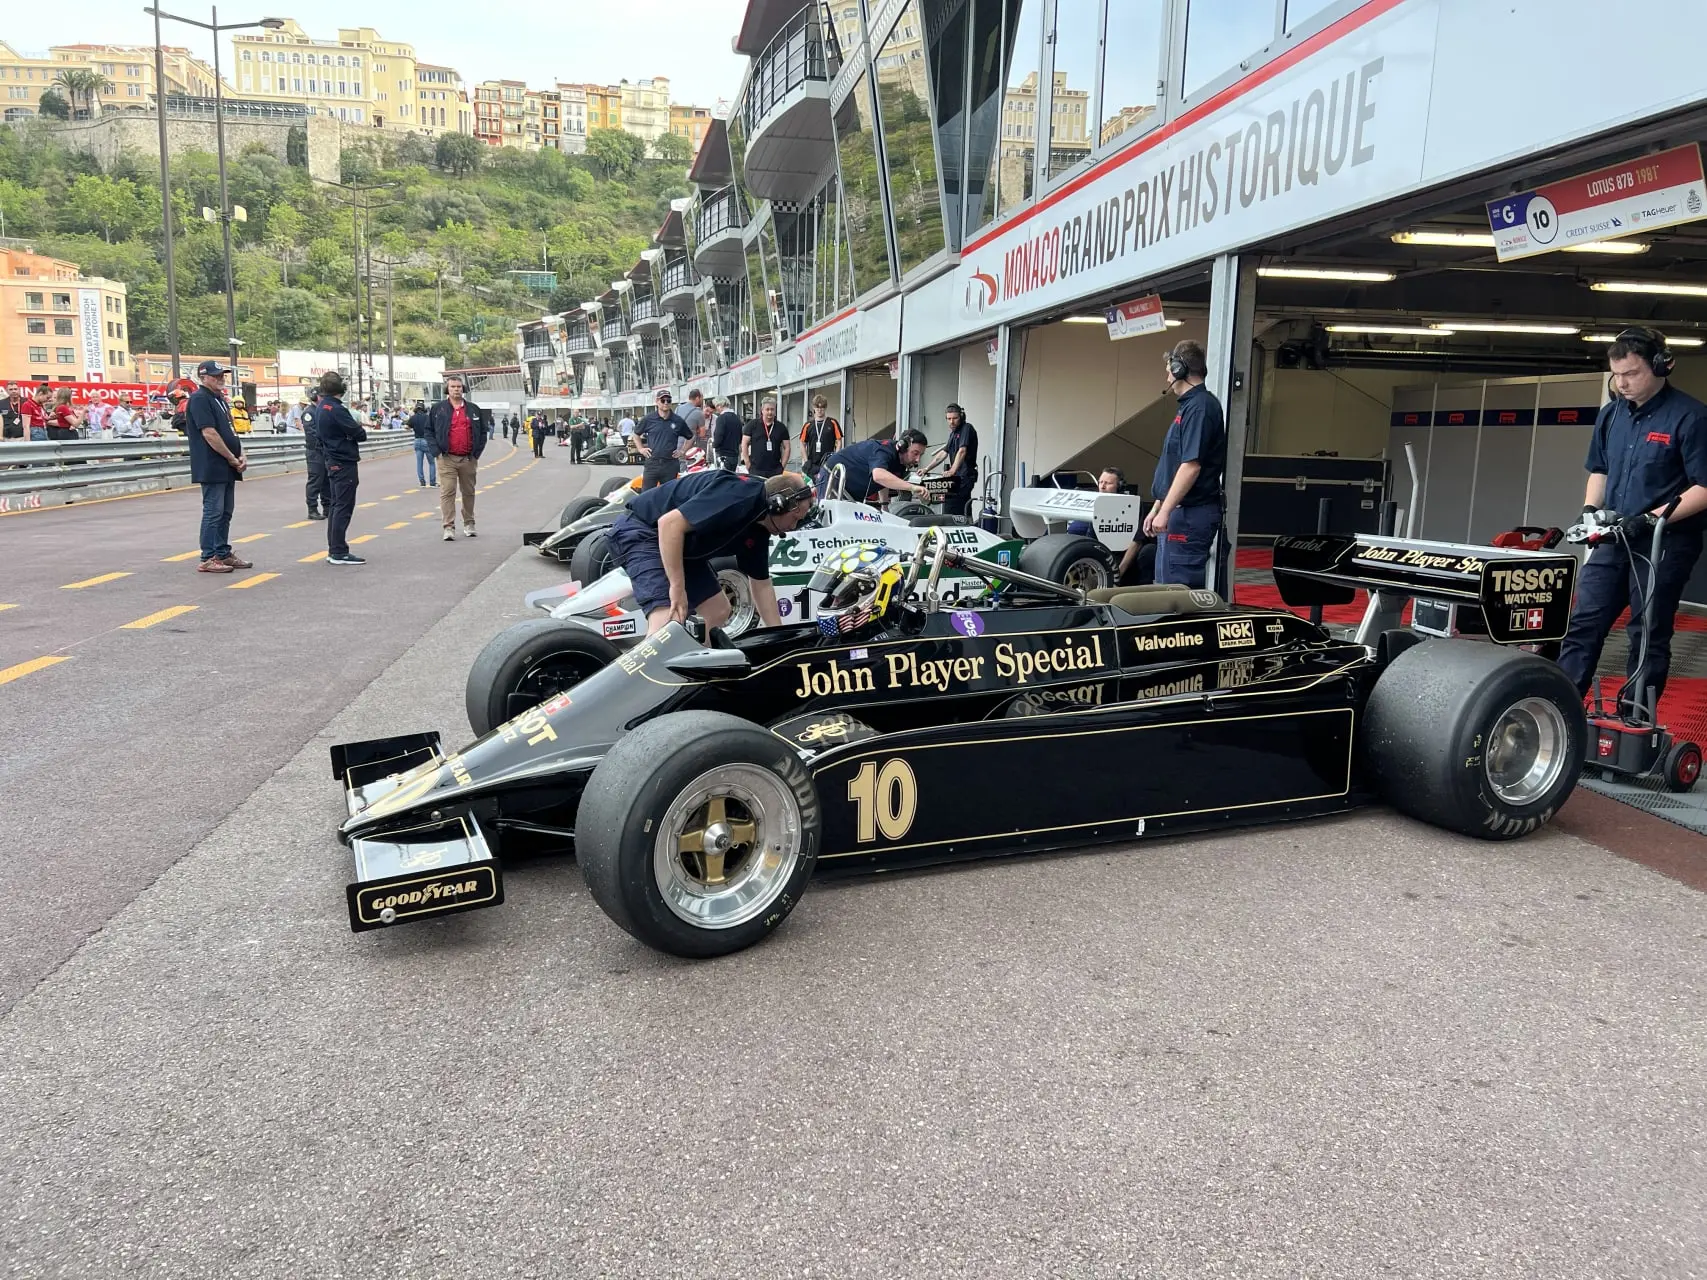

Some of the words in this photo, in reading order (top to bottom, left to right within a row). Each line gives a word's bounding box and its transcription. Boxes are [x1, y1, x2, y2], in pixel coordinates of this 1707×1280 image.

[1586, 177, 1615, 197] LOTUS
[1616, 172, 1634, 190] 87B
[1502, 205, 1515, 223] G
[1533, 210, 1550, 230] 10
[1565, 226, 1589, 239] CREDIT
[1589, 212, 1611, 234] SUISSE
[923, 481, 954, 489] TISSOT
[854, 511, 883, 523] Mobil
[1098, 523, 1133, 533] saudia
[1358, 545, 1397, 561] John
[1398, 549, 1456, 570] Player
[1491, 568, 1568, 592] TISSOT
[1504, 592, 1553, 605] WATCHES
[605, 622, 634, 633] CHAMPION
[963, 619, 976, 630] G
[966, 629, 977, 637] 10
[1219, 622, 1252, 640] NGK
[1135, 632, 1204, 651] Valvoline
[795, 659, 876, 698] John
[885, 652, 985, 692] Player
[995, 635, 1105, 683] Special
[773, 755, 819, 831] AVON
[848, 757, 918, 843] 10
